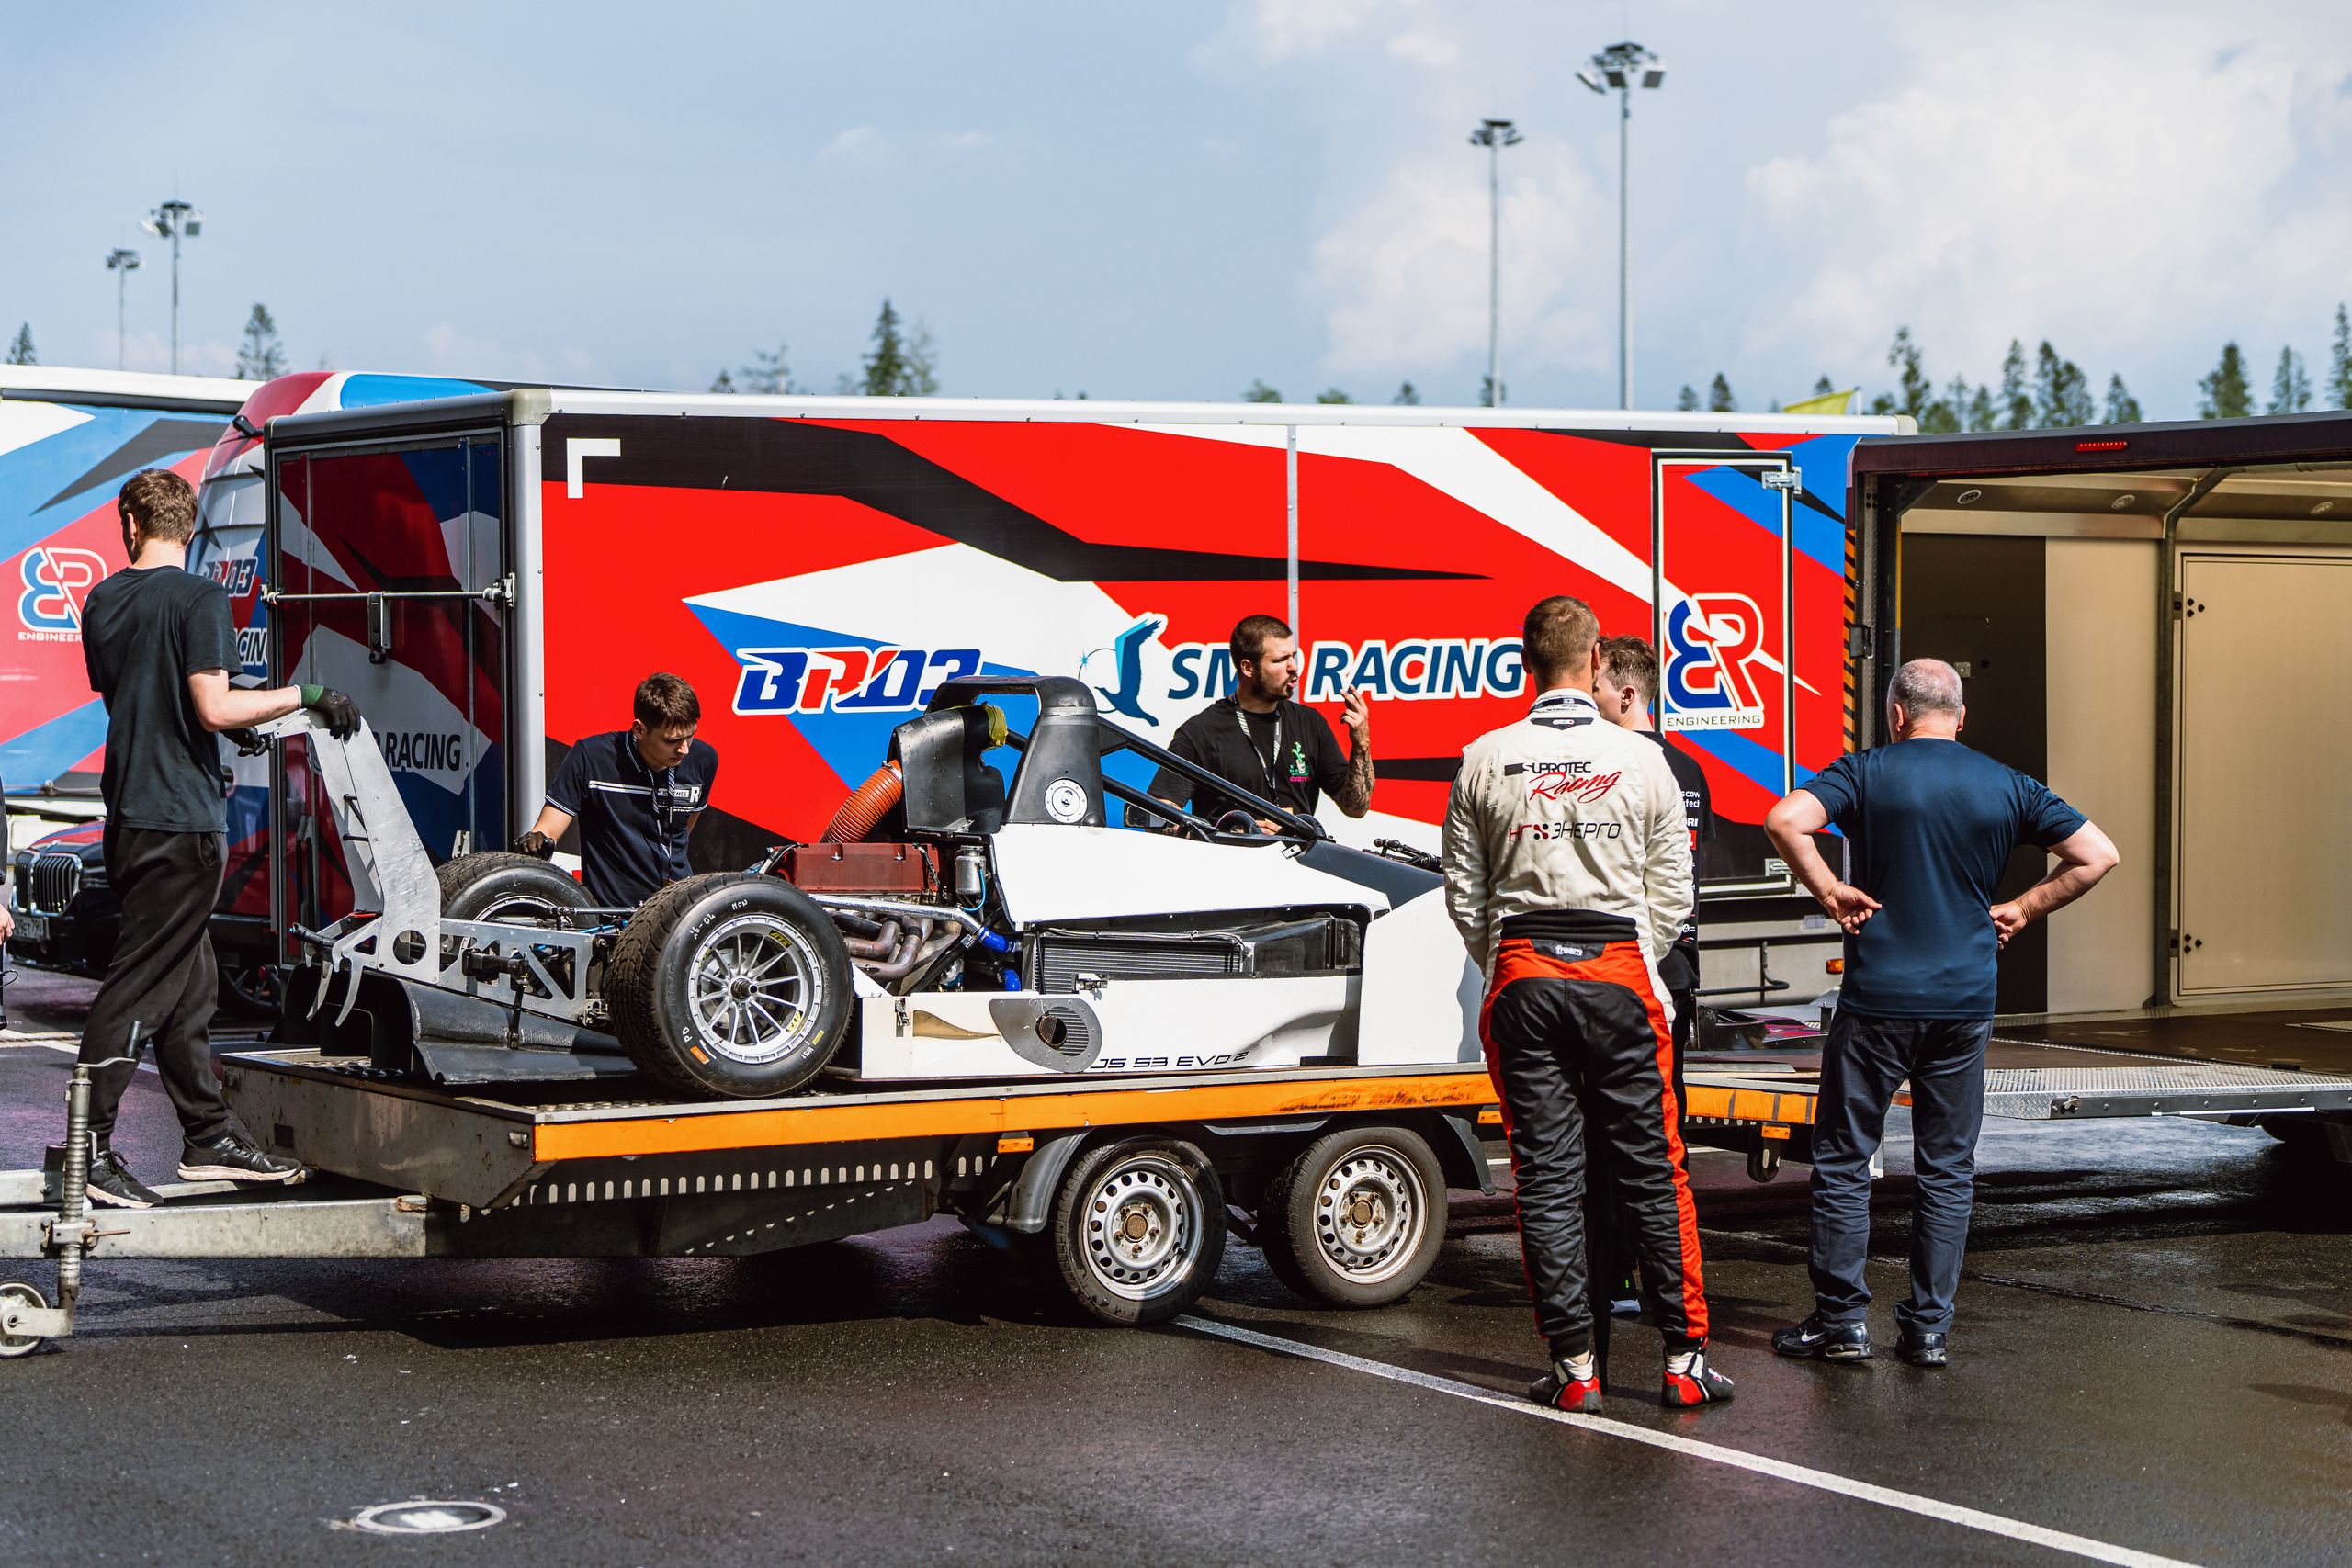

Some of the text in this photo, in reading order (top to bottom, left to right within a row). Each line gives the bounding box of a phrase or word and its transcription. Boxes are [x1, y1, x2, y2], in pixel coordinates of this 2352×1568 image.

[17, 631, 82, 642] ENGINEER
[1310, 642, 1523, 697] RACING
[1666, 714, 1761, 728] ENGINEERING
[385, 732, 462, 772] RACING
[1521, 761, 1592, 774] SUPROTEC
[1529, 771, 1623, 804] Racing
[1551, 822, 1622, 840] ЭНЕРГО
[1090, 1058, 1127, 1069] JS
